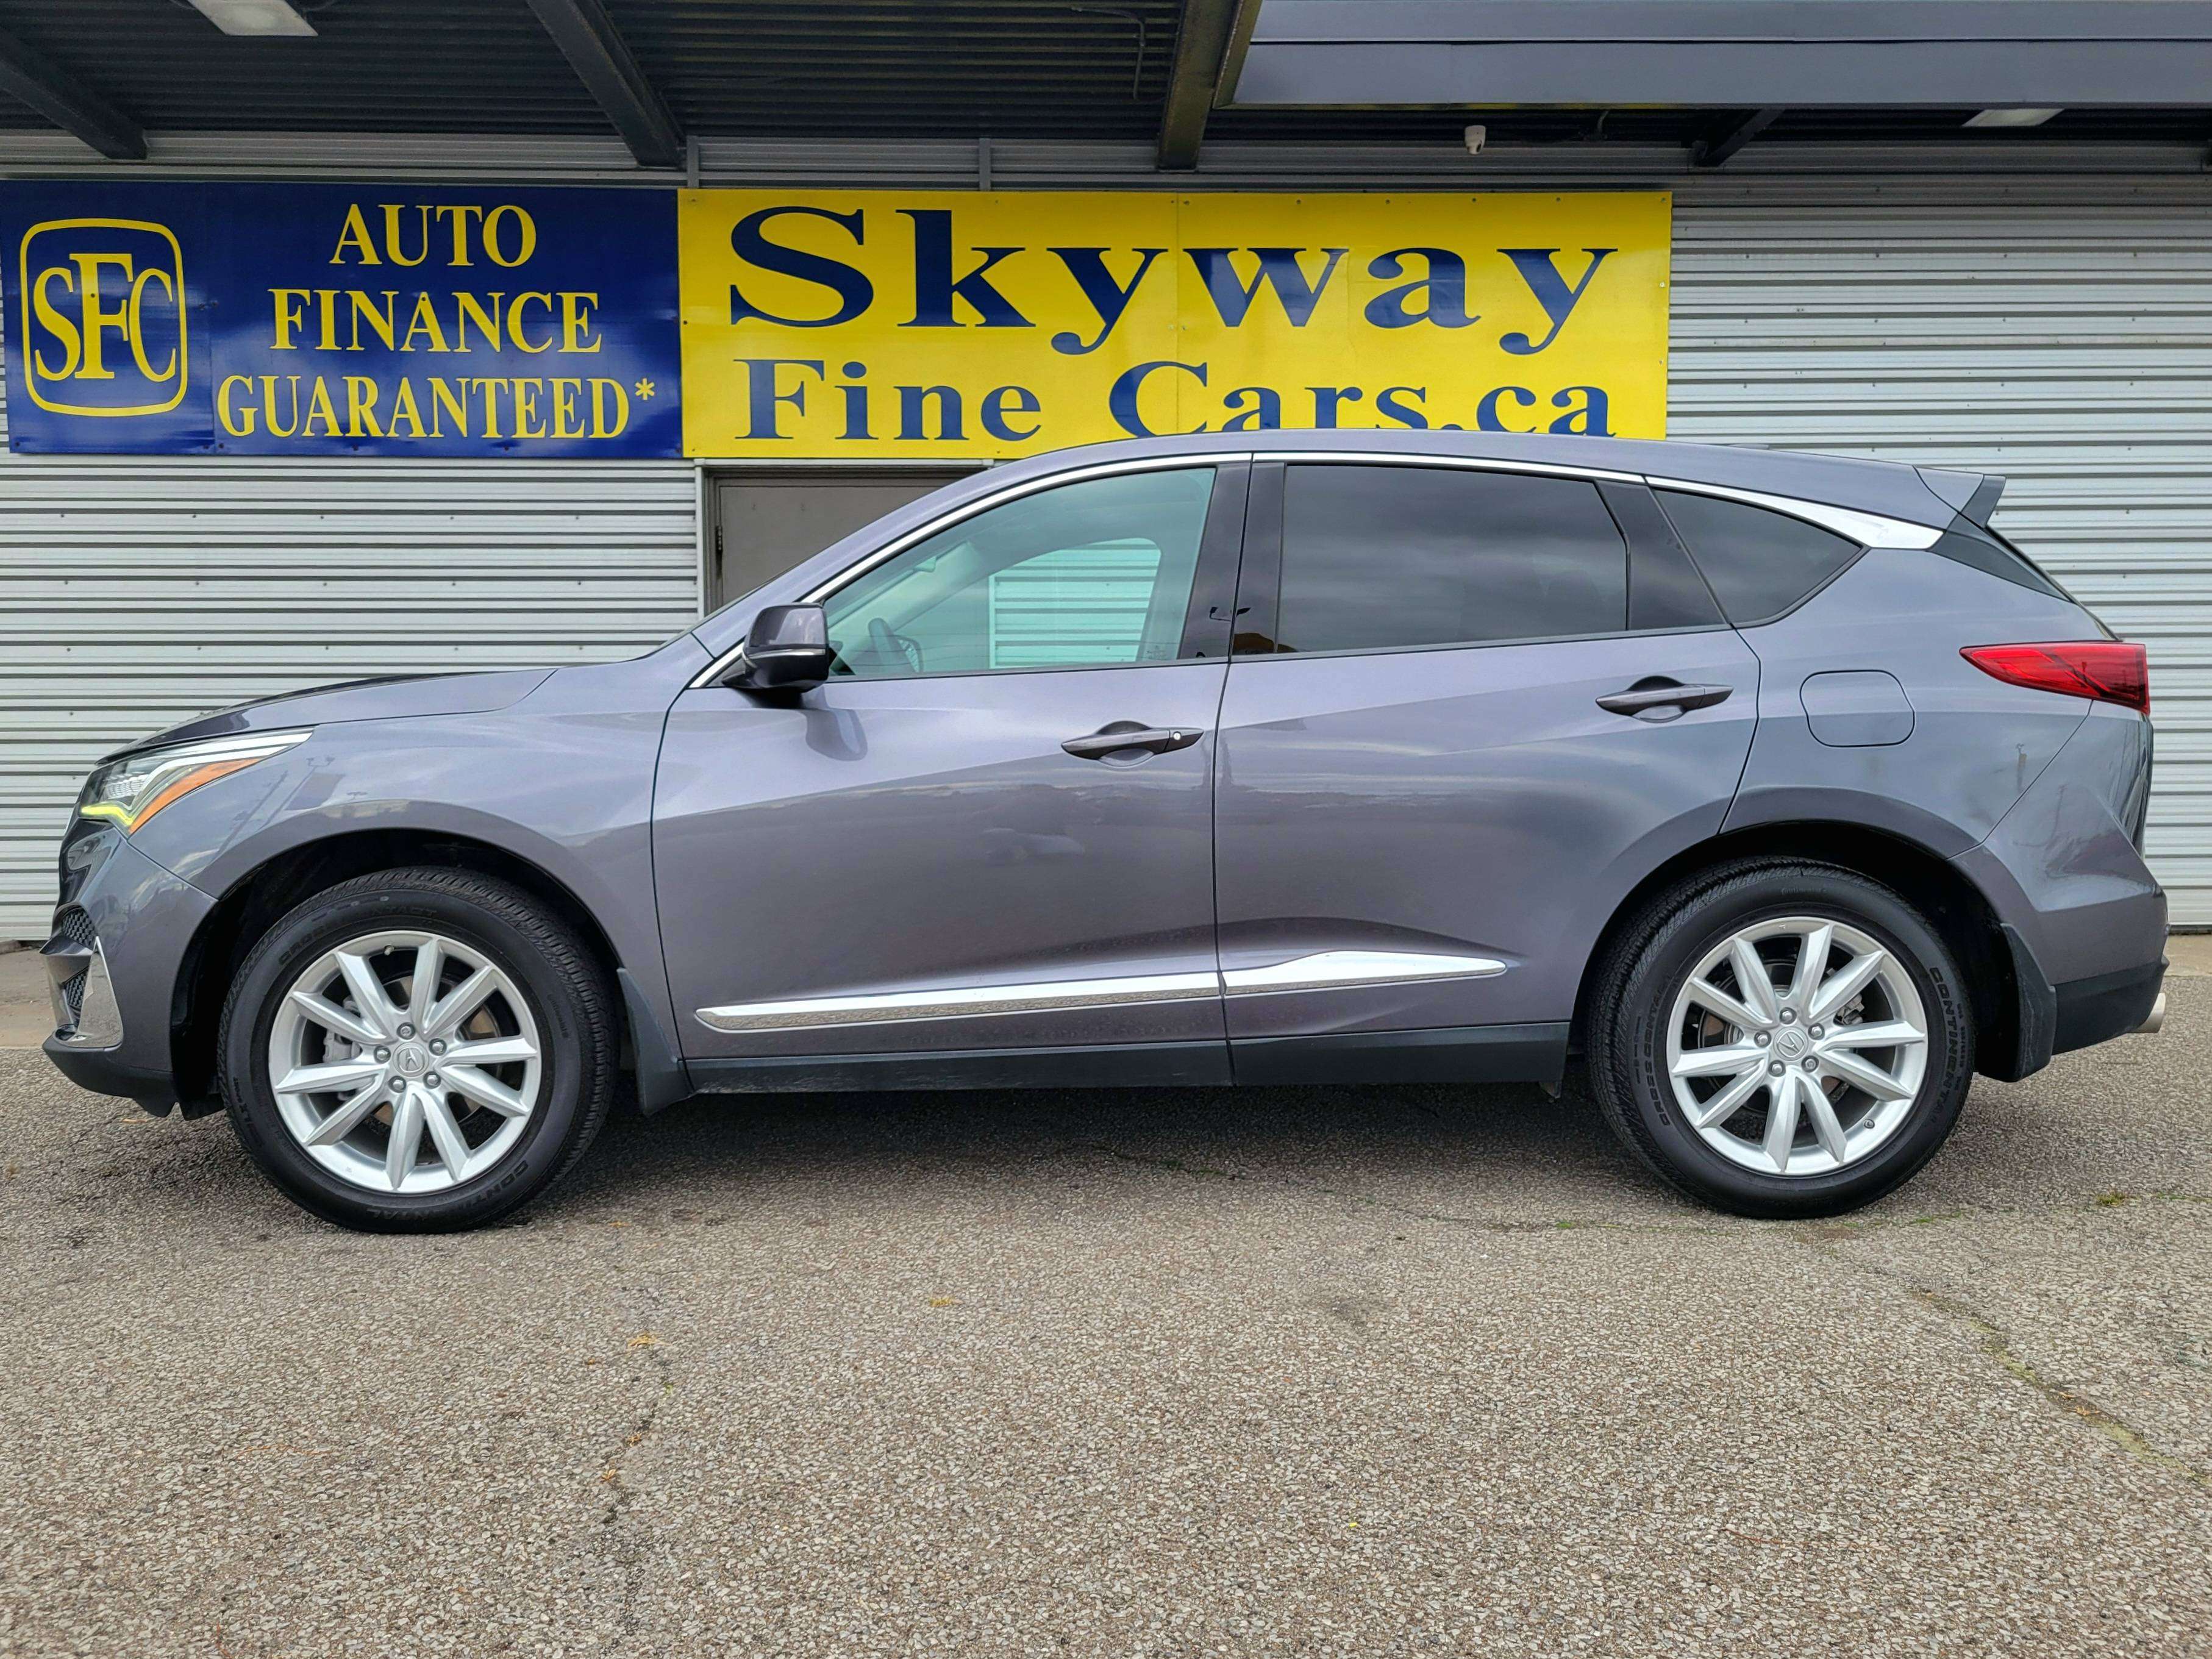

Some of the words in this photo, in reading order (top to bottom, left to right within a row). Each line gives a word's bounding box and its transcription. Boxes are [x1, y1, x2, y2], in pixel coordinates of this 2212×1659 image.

[330, 204, 537, 268] AUTO
[730, 205, 1619, 355] Skyway
[33, 252, 177, 382] SFC
[269, 288, 602, 353] FINANCE
[733, 359, 1042, 441] Fine
[366, 1159, 529, 1220] CONTINTAL
